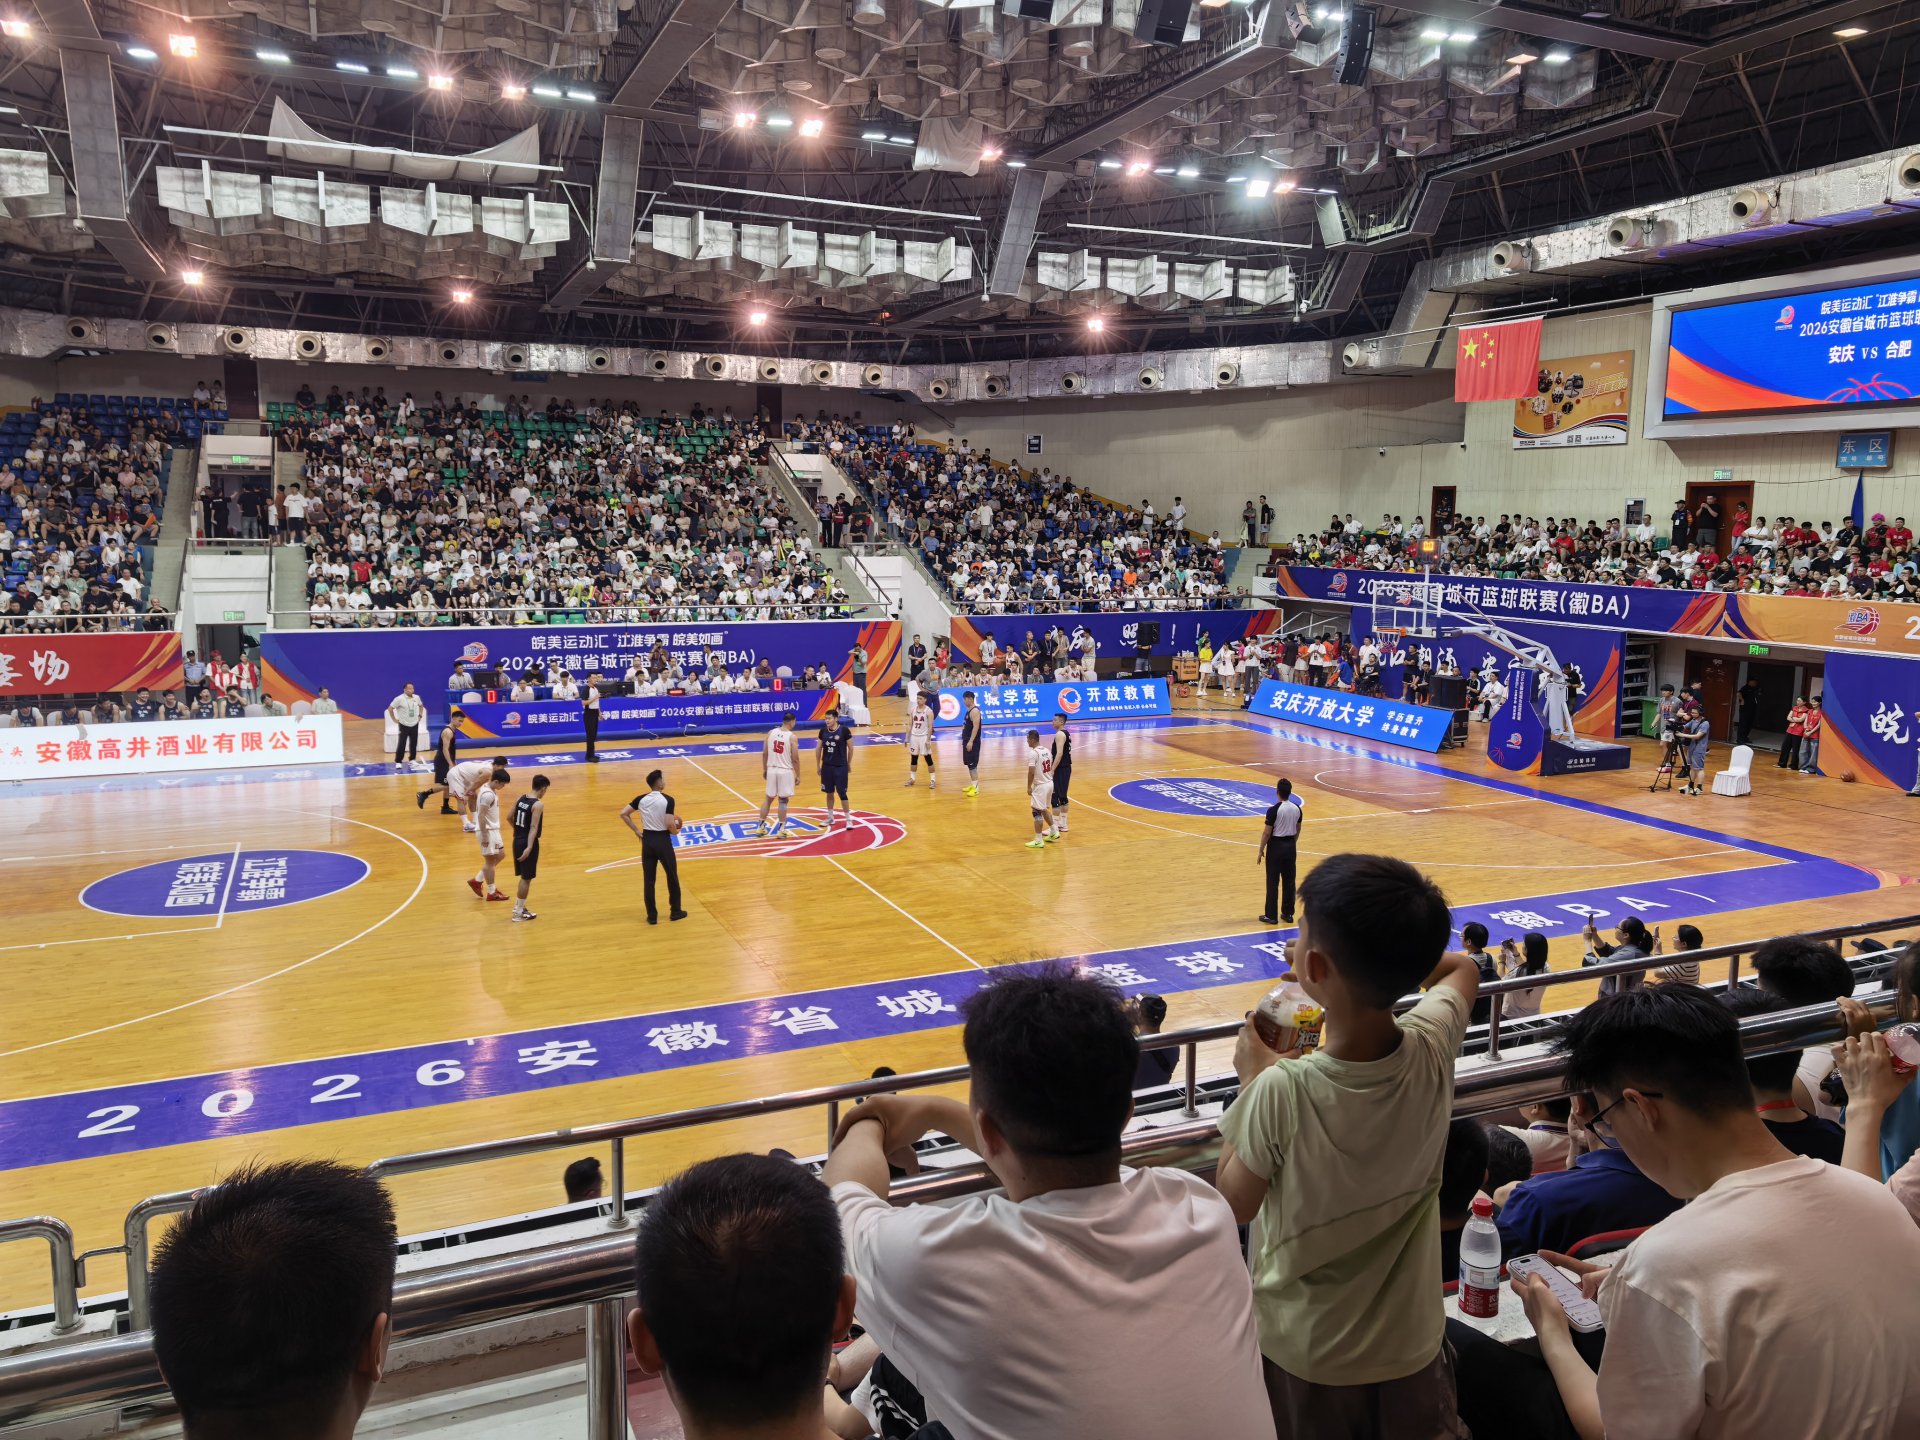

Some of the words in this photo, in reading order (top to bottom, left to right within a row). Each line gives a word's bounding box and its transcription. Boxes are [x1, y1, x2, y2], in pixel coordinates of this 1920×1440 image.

[1820, 295, 1873, 315] 皖美运动汇
[1828, 344, 1856, 364] 安庆
[1885, 339, 1912, 359] 合肥
[531, 634, 609, 651] 皖美运动汇
[1086, 683, 1156, 702] 开放教育
[1269, 688, 1376, 728] 安庆开放大学
[527, 711, 579, 724] 皖美运动汇
[1380, 722, 1420, 739] 终身教育
[35, 729, 318, 764] 安徽高井酒业有限公司
[772, 739, 785, 755] 15
[515, 810, 525, 828] 11
